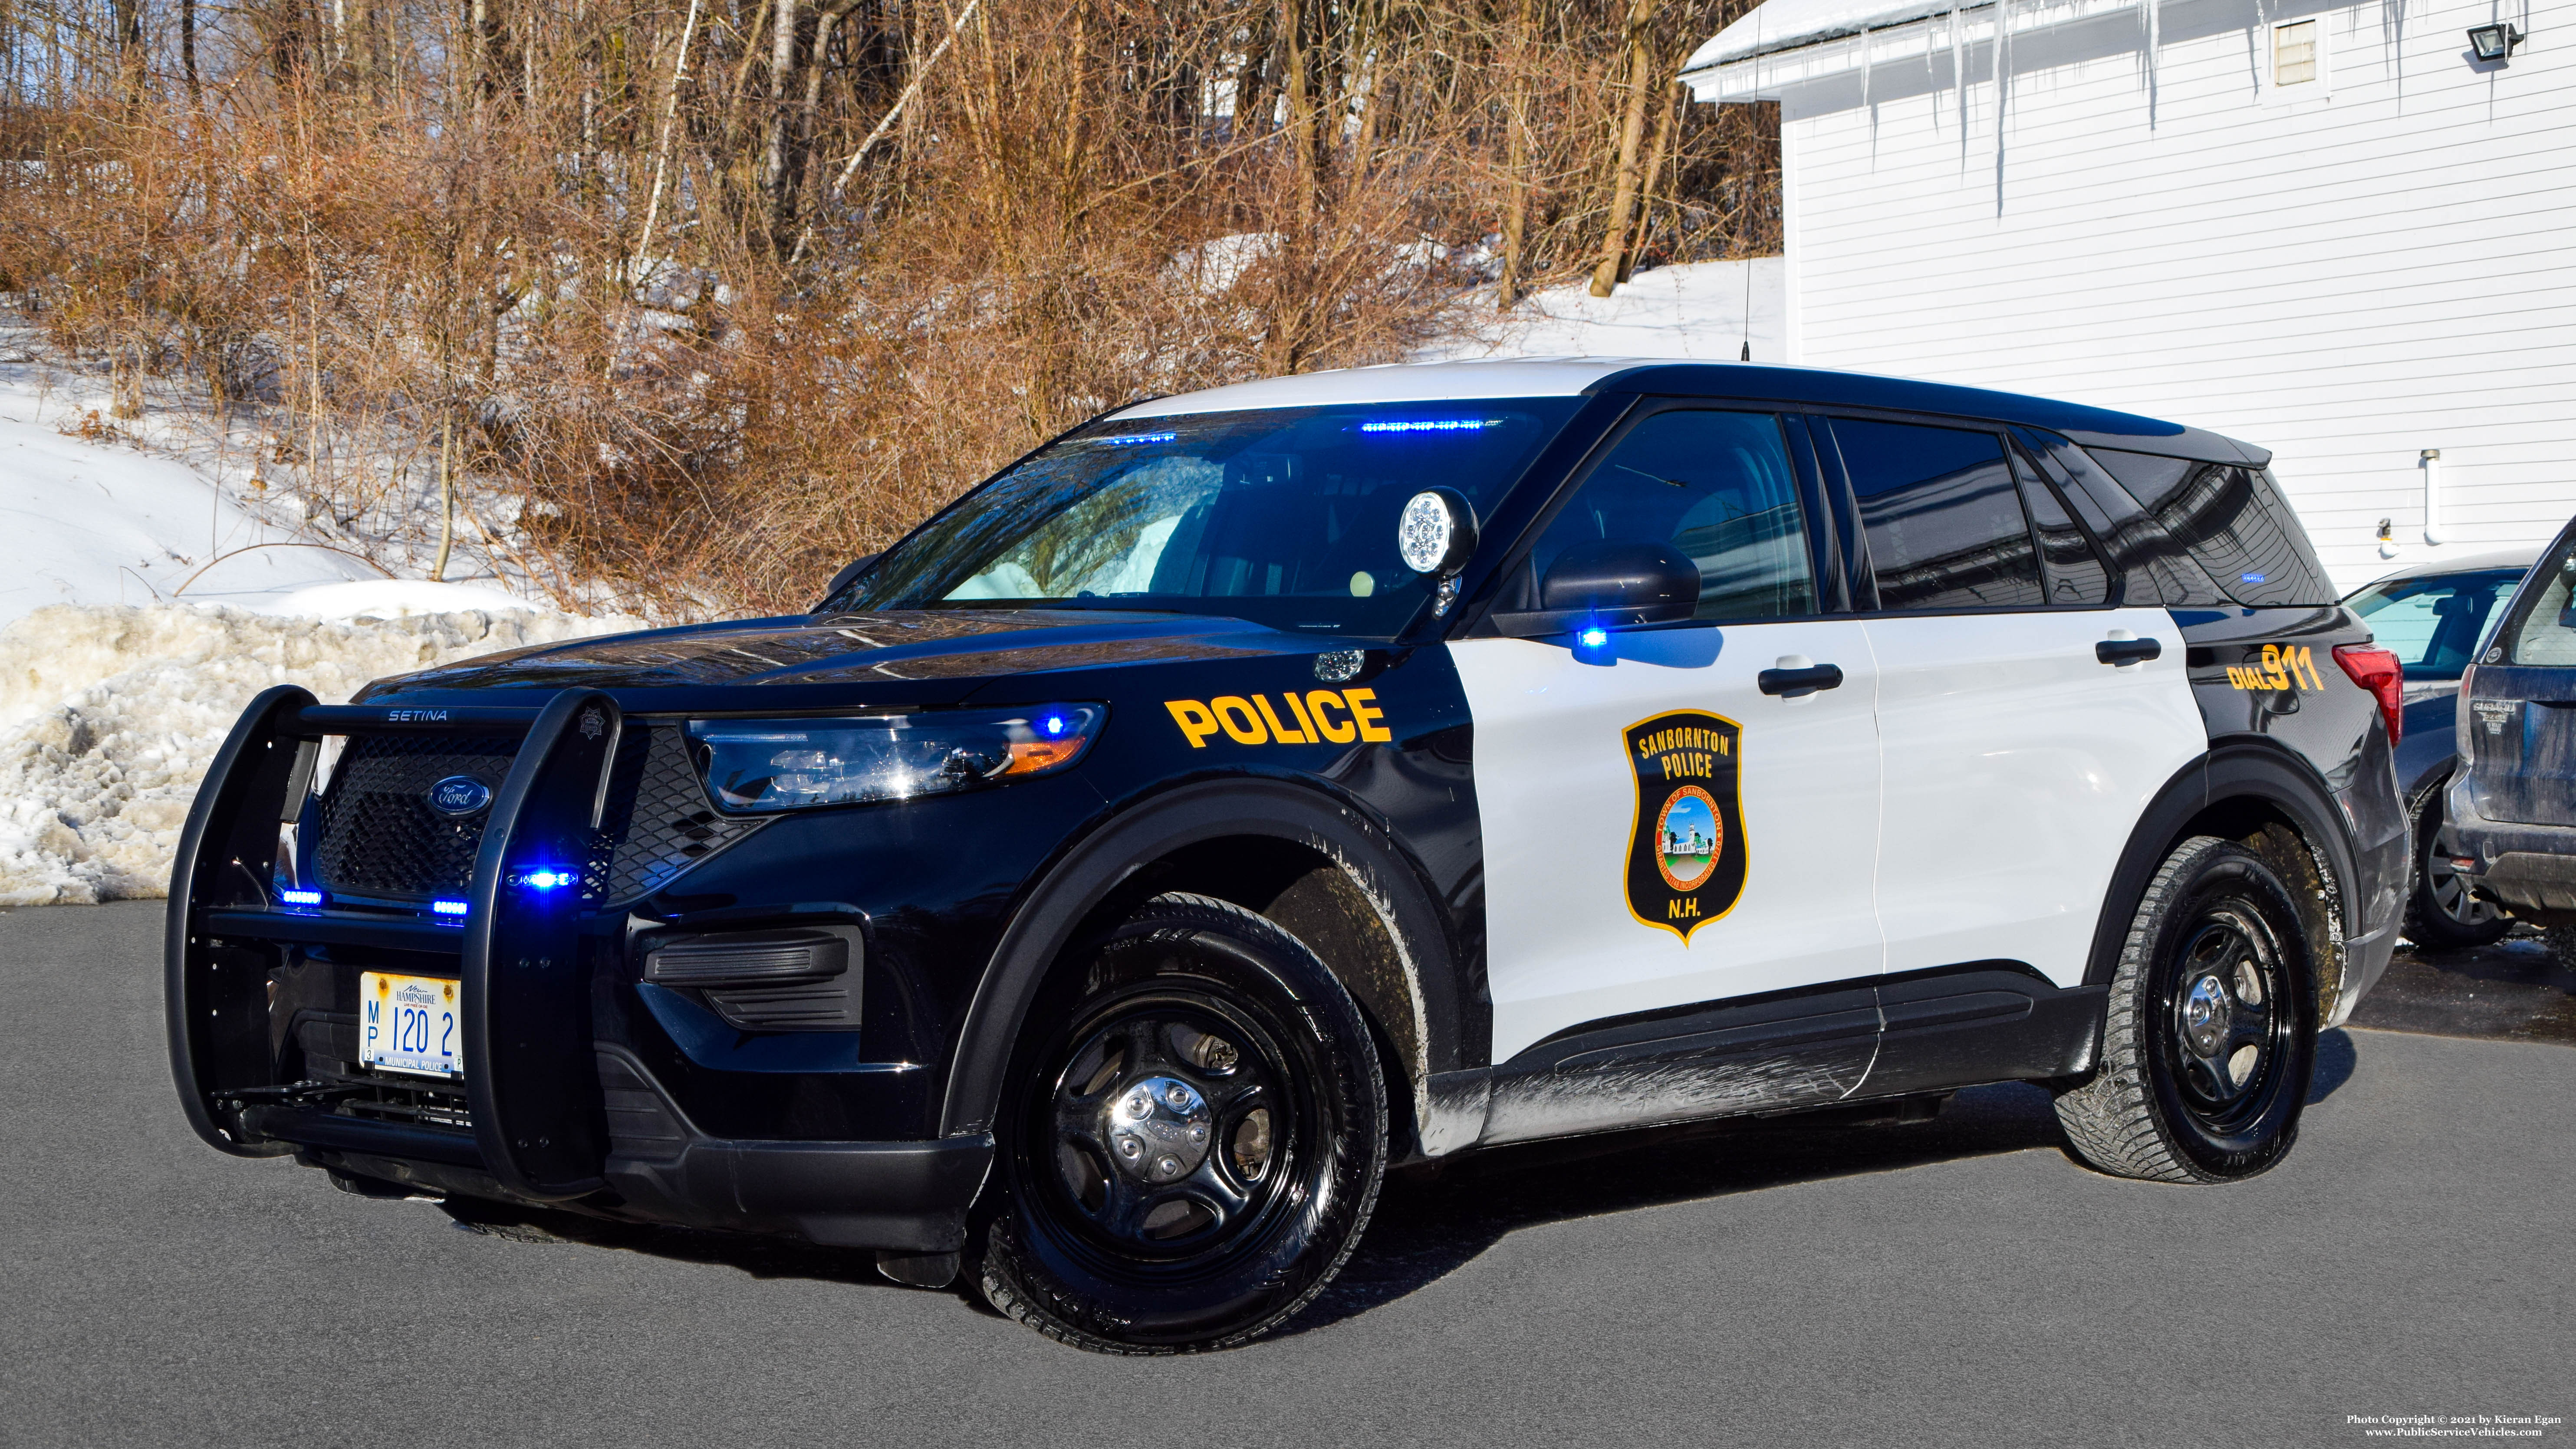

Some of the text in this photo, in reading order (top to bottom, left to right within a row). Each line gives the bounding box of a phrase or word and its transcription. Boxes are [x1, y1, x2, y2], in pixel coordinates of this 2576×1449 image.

[2226, 644, 2324, 690] DIAL 911
[389, 710, 447, 721] SETINA
[1164, 688, 1392, 748] POLICE
[2473, 703, 2516, 713] SUBARU
[1639, 727, 1728, 759] SANBORNTON
[1661, 752, 1712, 780] POLICE
[438, 784, 473, 805] Ford
[1658, 788, 1721, 832] TOWN OF SANBORNTON
[1657, 845, 1670, 879] GRANTED
[1669, 877, 1679, 888] 1748
[1680, 861, 1714, 889] INCORPORATED
[1669, 897, 1701, 919] N.H.
[396, 991, 436, 1005] HAMPSHIRE
[404, 985, 428, 993] New
[393, 1007, 453, 1056] 120 2
[367, 1049, 372, 1060] 3
[385, 1056, 442, 1072] MUNICIPAL POLICE
